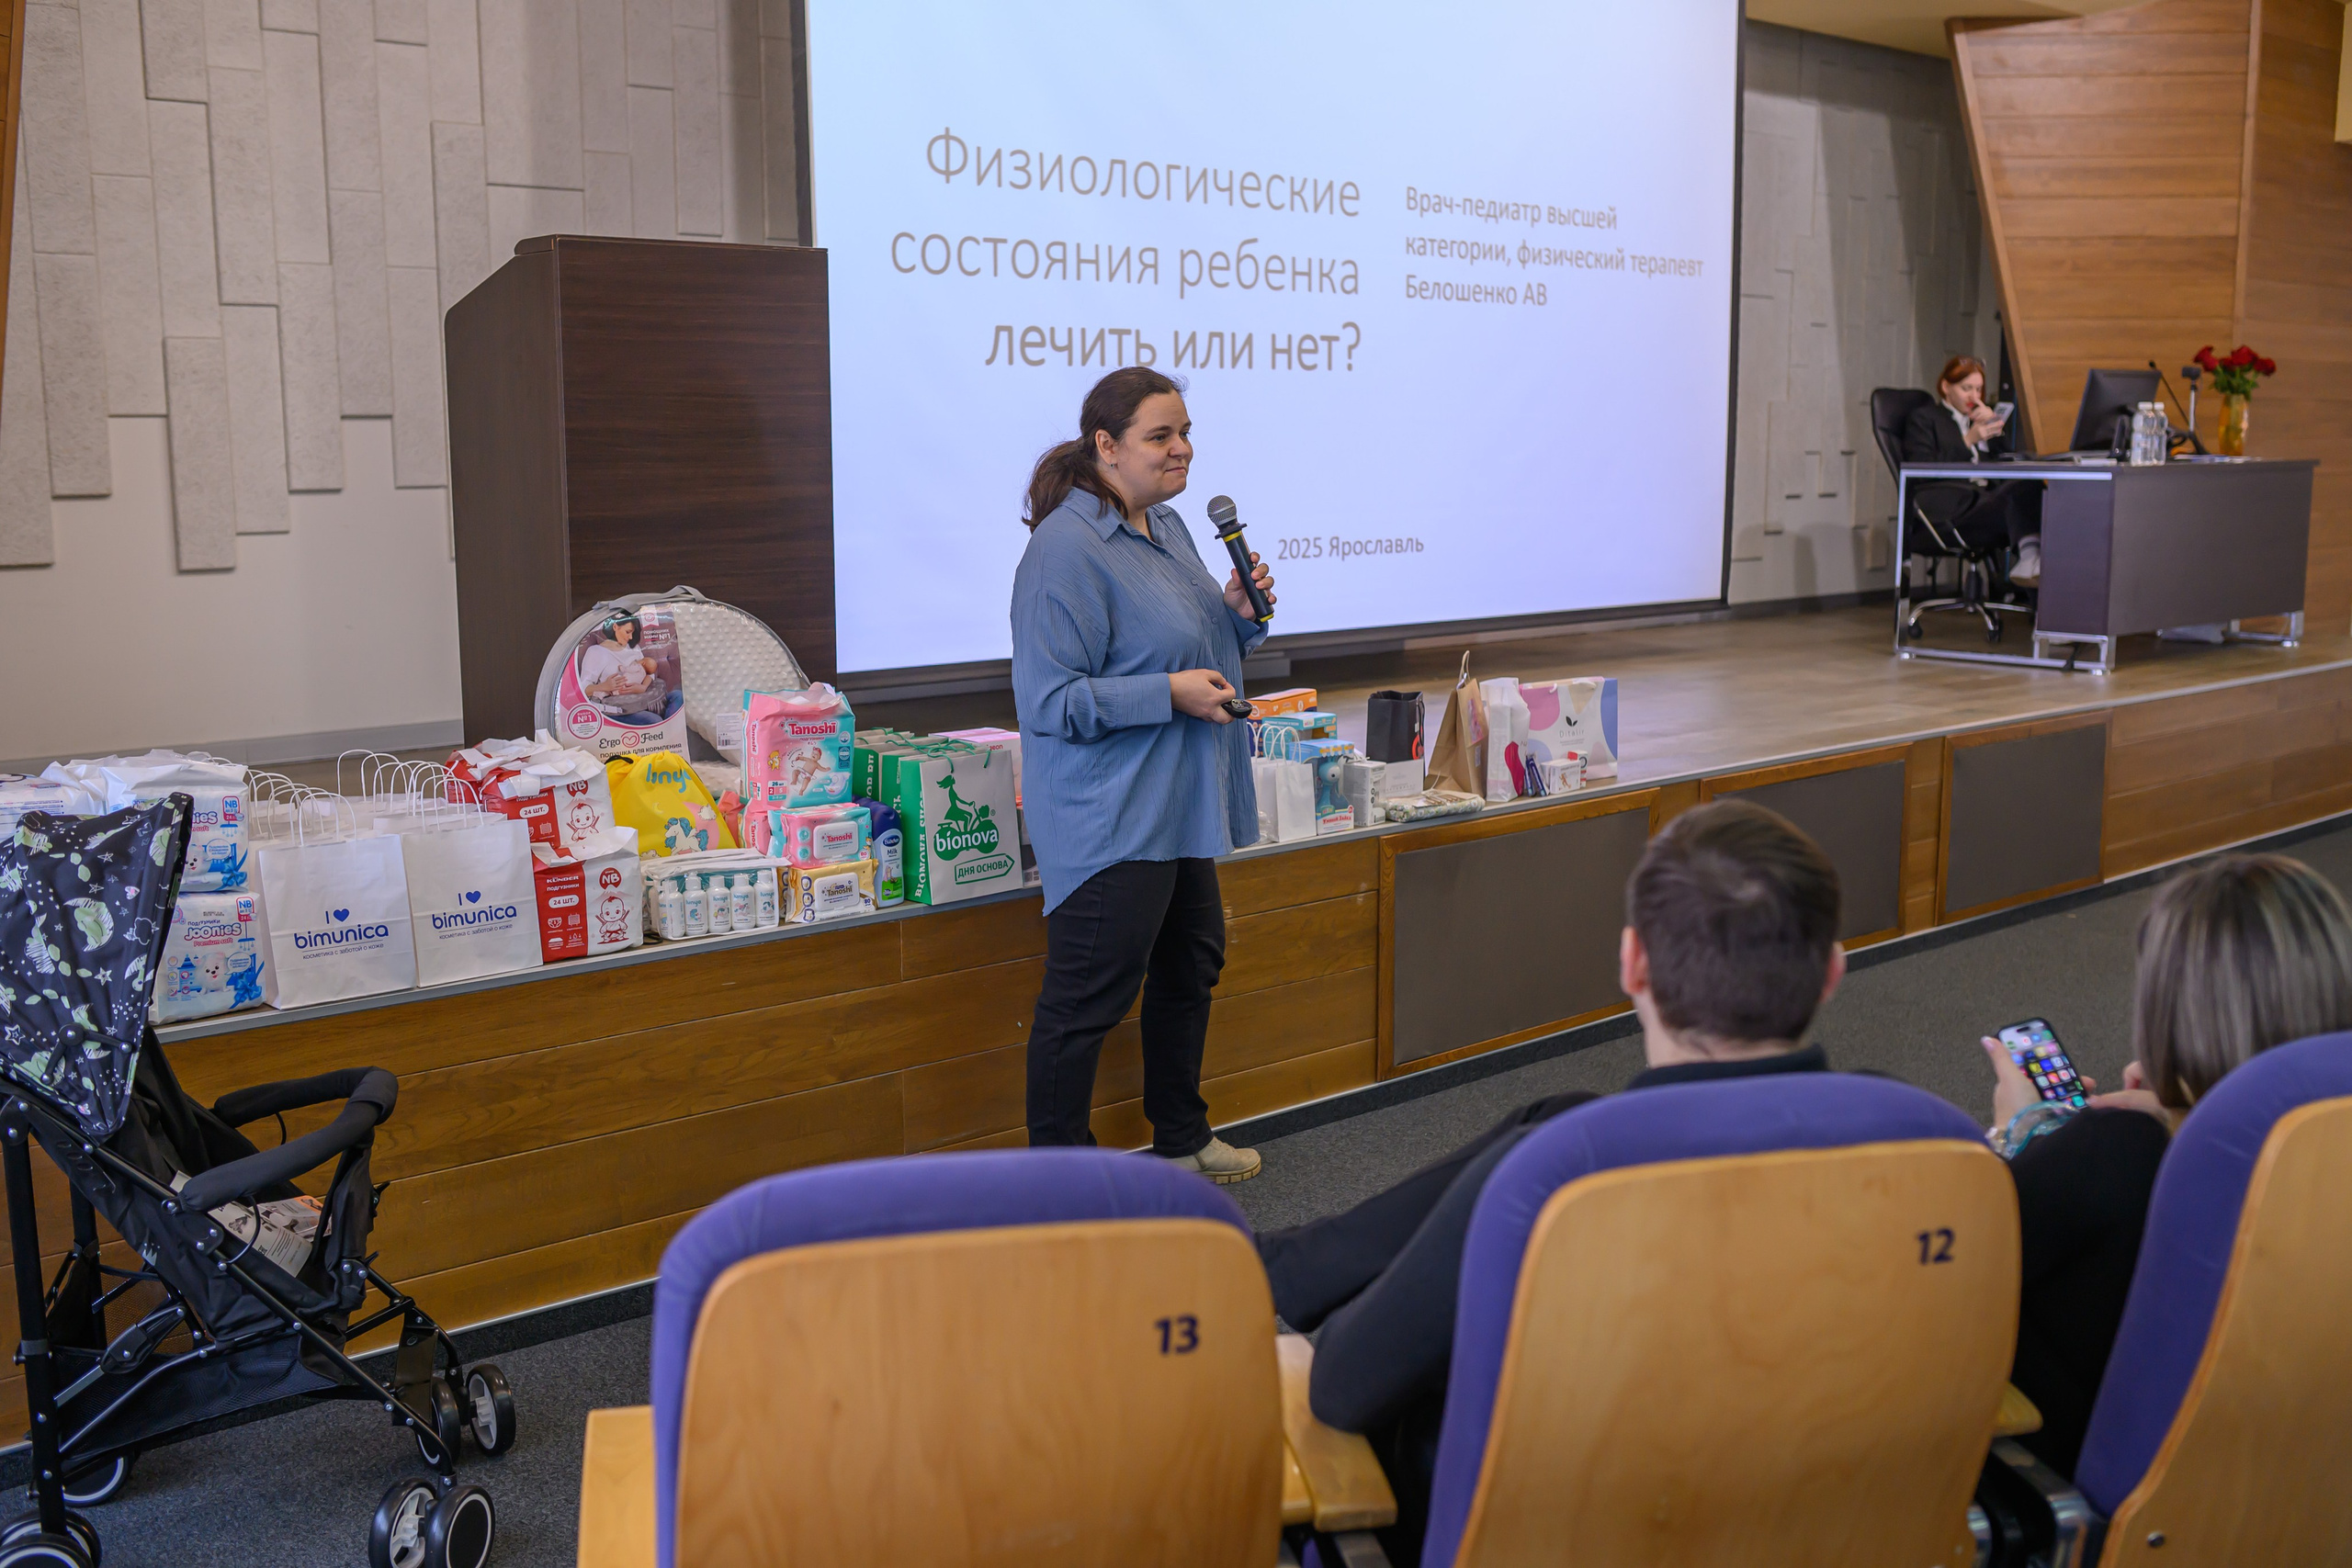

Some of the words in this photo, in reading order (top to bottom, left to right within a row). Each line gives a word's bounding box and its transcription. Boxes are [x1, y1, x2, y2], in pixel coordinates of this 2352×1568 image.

[927, 127, 1360, 217] Физиологические
[1407, 186, 1541, 228] Врач-педиатр
[1547, 206, 1617, 230] высшей
[891, 231, 1159, 285] состояния
[1180, 238, 1358, 299] ребенка
[1407, 237, 1510, 265] категории,
[1518, 243, 1624, 273] физический
[1630, 254, 1703, 278] терапевт
[1407, 275, 1516, 305] Белошенко
[1522, 282, 1547, 306] АВ
[985, 324, 1156, 368] лечить
[1173, 331, 1253, 369] или
[1271, 321, 1361, 371] нет?
[1278, 537, 1322, 559] 2025
[1329, 536, 1424, 560] Ярославль
[577, 715, 592, 723] №1
[788, 722, 836, 735] Tanoshi
[599, 738, 621, 749] Ergo
[640, 731, 663, 744] Feed
[645, 743, 682, 753] КОРМЛЕНИЯ
[570, 781, 587, 792] NB
[224, 800, 238, 808] NB
[827, 833, 853, 842] Tanoshi
[935, 829, 999, 852] bionova
[958, 863, 975, 878] ДНЯ
[977, 860, 1009, 874] ОСНОВА
[602, 874, 619, 884] NB
[458, 893, 462, 906] I
[827, 886, 853, 897] Tanoshi
[239, 900, 252, 908] NB
[325, 911, 330, 924] I
[432, 906, 516, 930] bimunica
[294, 924, 389, 949] bimunica
[439, 931, 466, 940] косметика
[471, 926, 494, 935] заботой
[499, 923, 513, 931] коже
[303, 950, 334, 960] косметика
[339, 944, 363, 954] заботой
[1916, 1228, 1955, 1265] 12
[1155, 1315, 1200, 1354] 13
